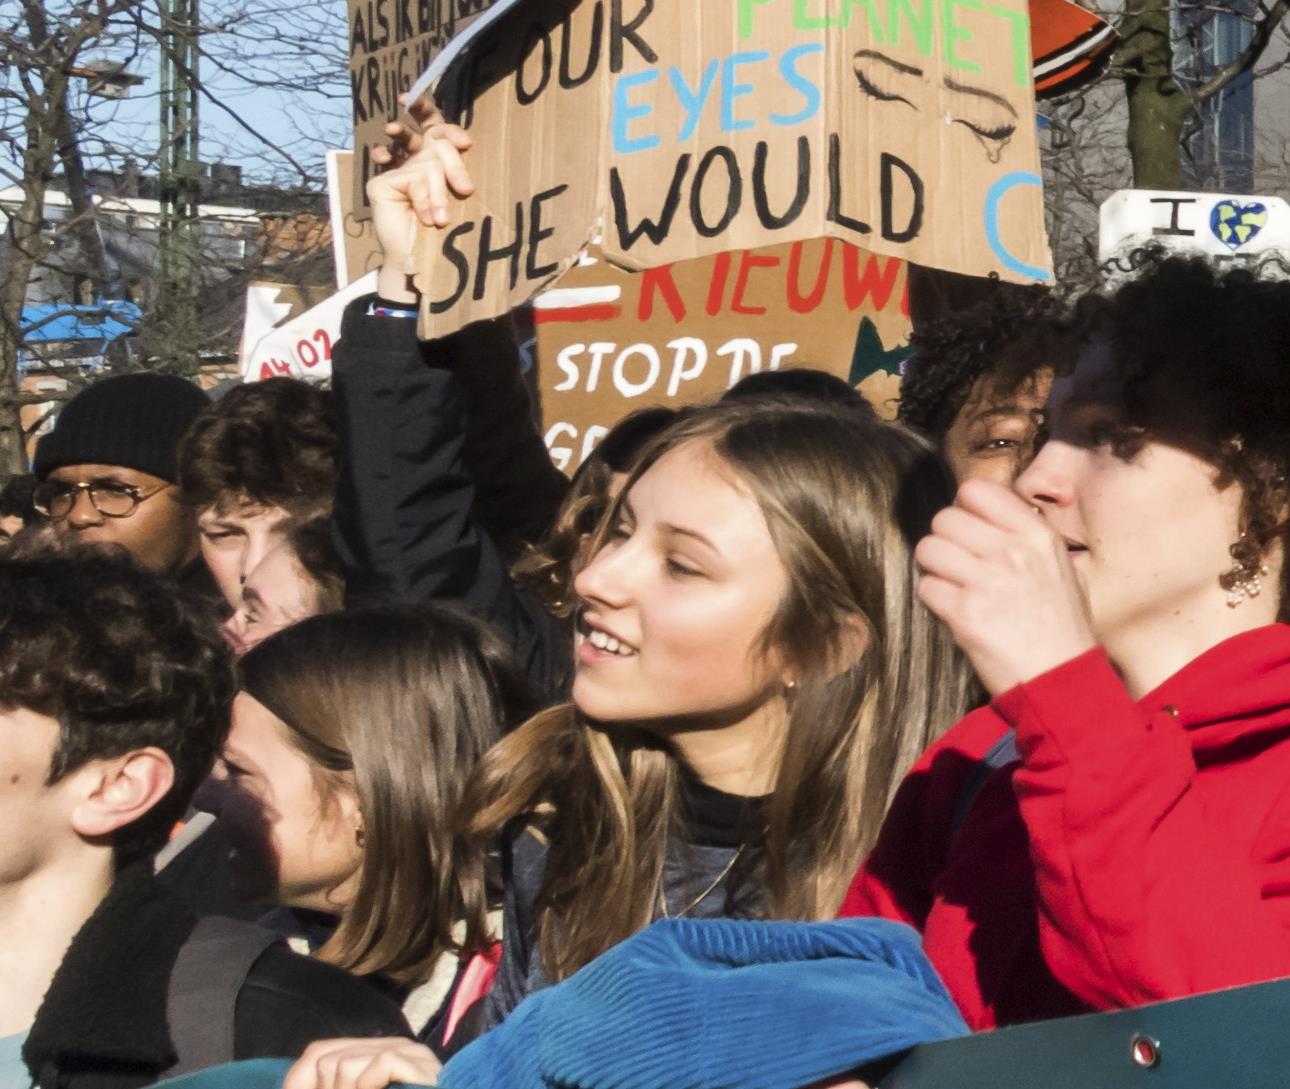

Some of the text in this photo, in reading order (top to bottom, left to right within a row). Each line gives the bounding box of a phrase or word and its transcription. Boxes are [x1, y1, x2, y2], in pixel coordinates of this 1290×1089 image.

[611, 43, 824, 154] EYES
[428, 183, 569, 314] SHE
[609, 132, 925, 252] WOULD
[1150, 198, 1196, 237] I
[553, 336, 709, 398] STOP
